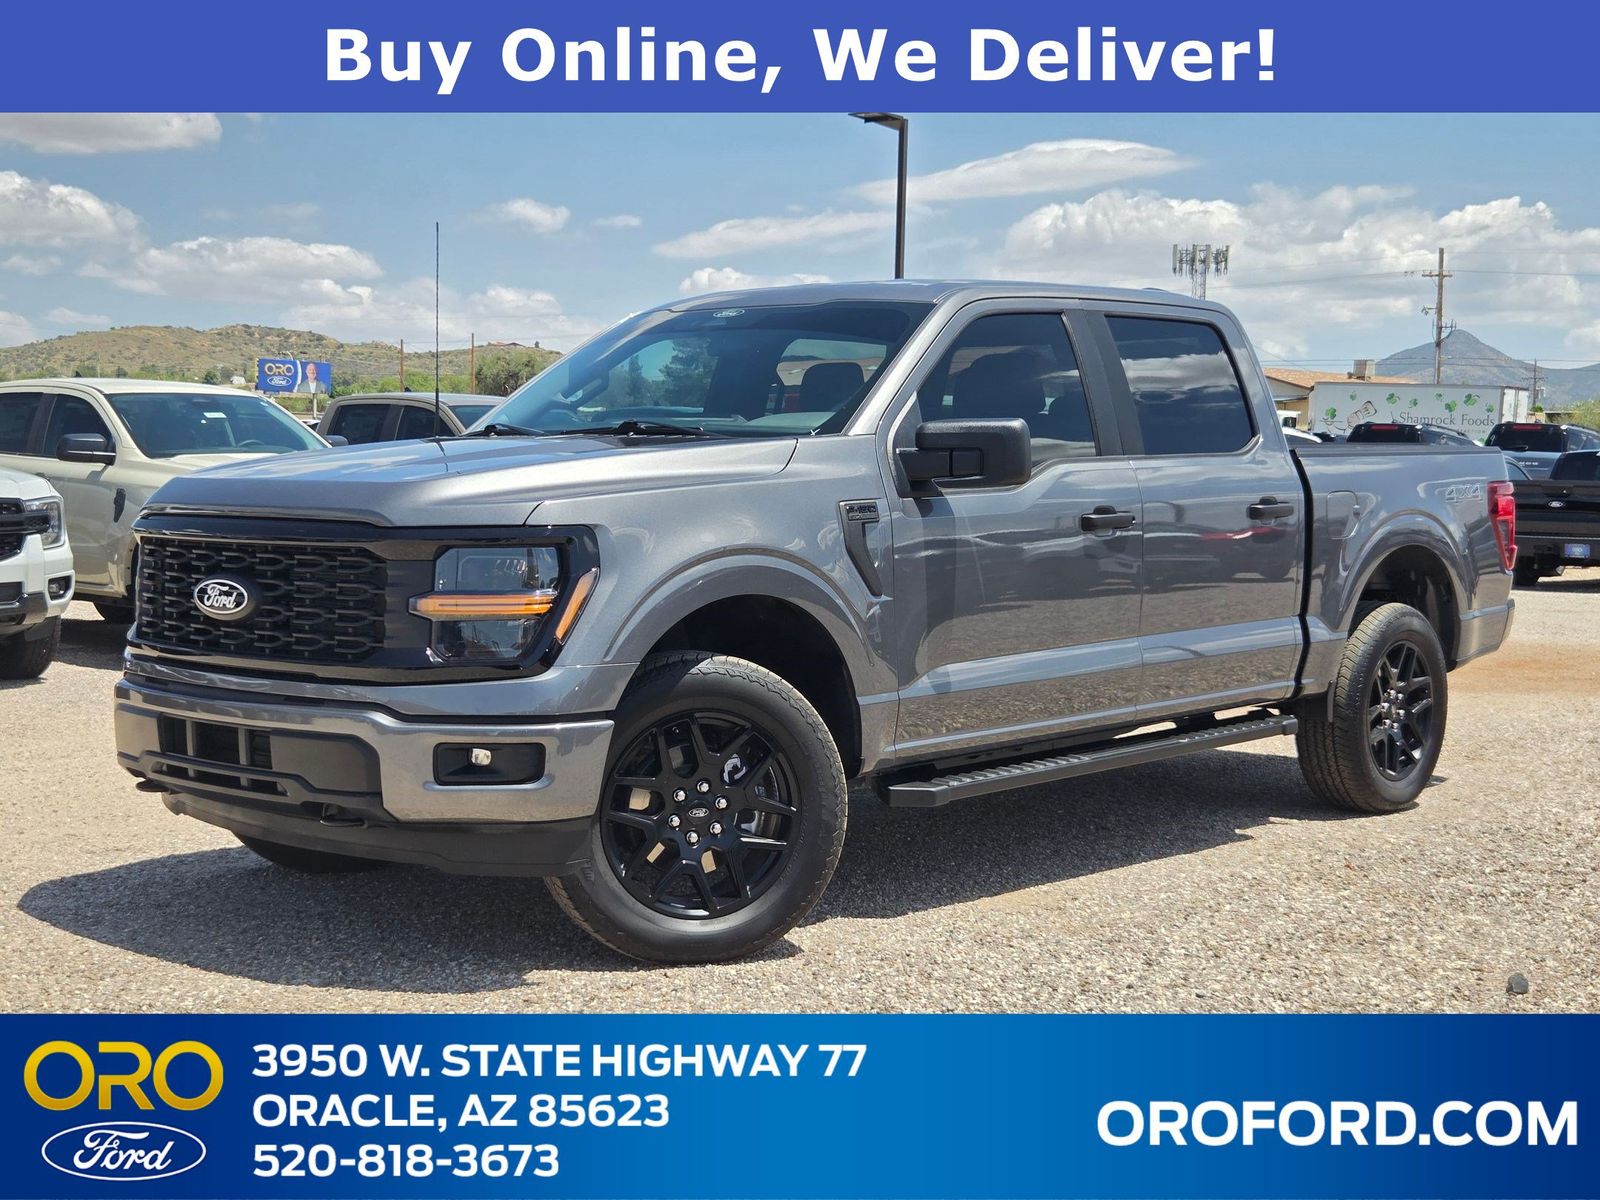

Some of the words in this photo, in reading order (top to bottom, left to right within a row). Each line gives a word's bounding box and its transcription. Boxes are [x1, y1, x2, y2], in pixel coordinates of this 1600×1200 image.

[265, 363, 294, 376] ORO
[1399, 411, 1456, 425] Shamrock
[1461, 413, 1496, 427] Foods
[203, 583, 237, 609] Ford
